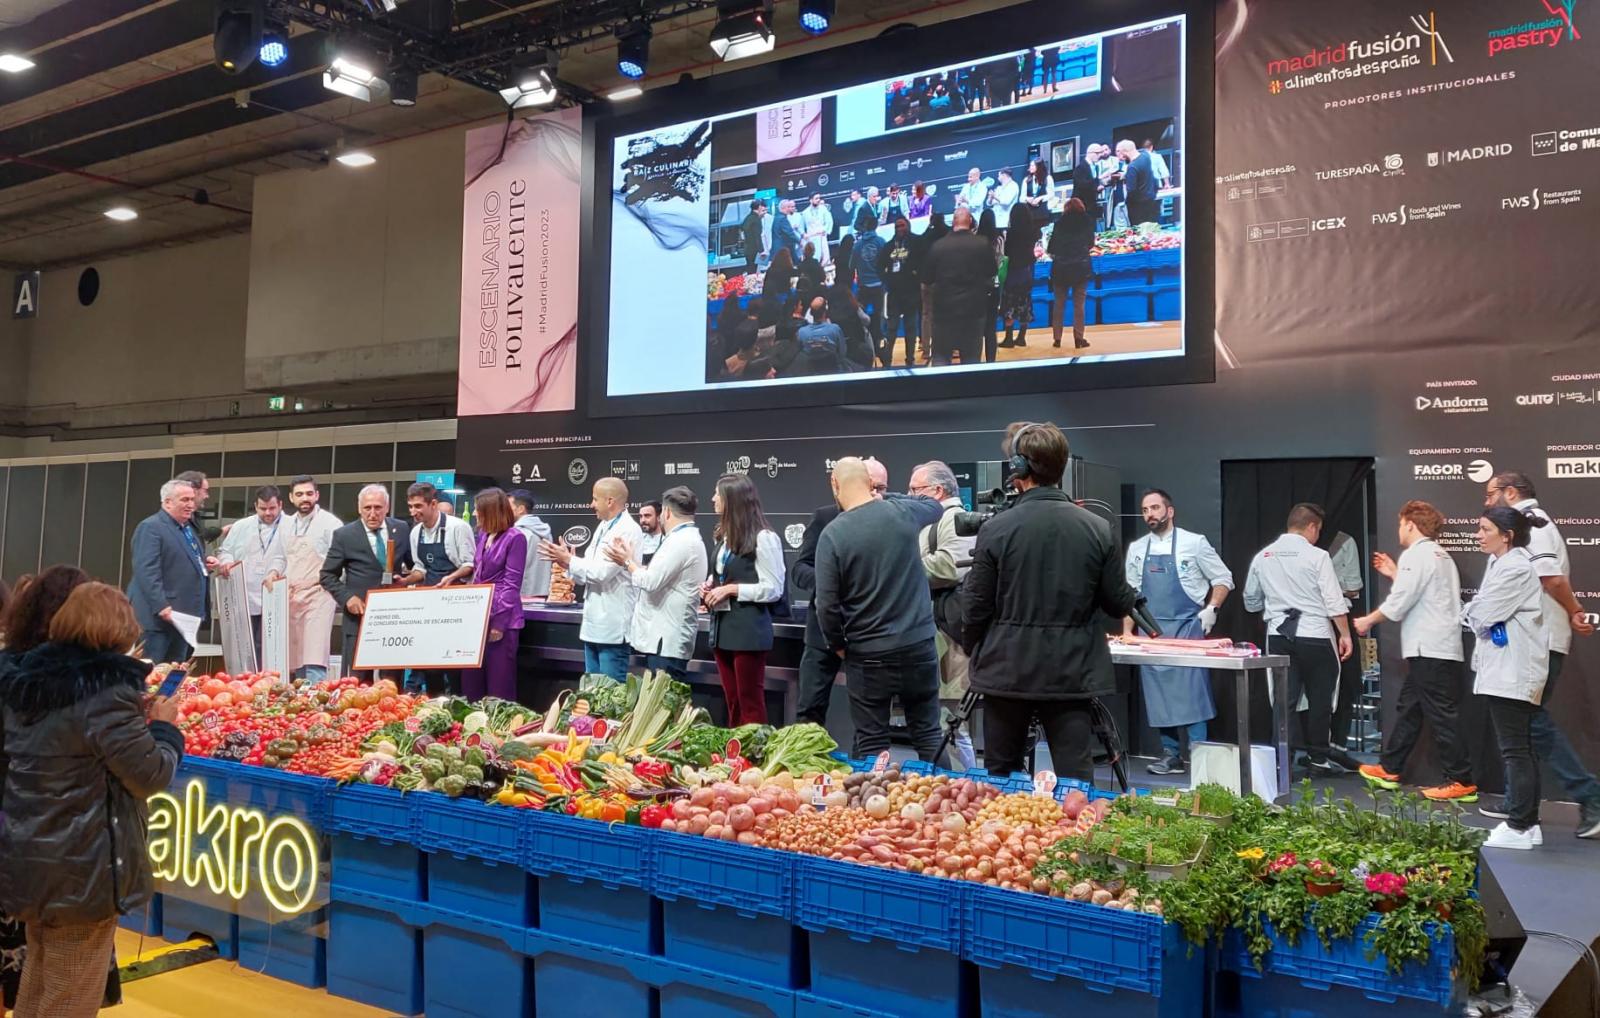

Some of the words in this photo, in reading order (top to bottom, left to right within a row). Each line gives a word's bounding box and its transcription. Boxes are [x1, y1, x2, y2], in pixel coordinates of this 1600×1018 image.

[1488, 27, 1564, 57] pastry
[1268, 54, 1420, 94] #alimentosdespaña
[1324, 89, 1403, 110] PROMOTORES
[1407, 70, 1516, 96] INSTITUCIONALES
[1559, 141, 1578, 152] de
[1447, 143, 1513, 163] MADRID
[1315, 164, 1380, 181] TURESPAÑA
[1543, 188, 1582, 199] Restaurants
[1560, 196, 1580, 205] Spain
[1409, 206, 1427, 214] Foods
[1441, 202, 1462, 211] Wines
[1426, 210, 1446, 219] Spain
[539, 208, 550, 334] #MadridFusion2023
[479, 190, 501, 368] ESCENARIO
[16, 279, 34, 314] A
[1432, 396, 1488, 409] Andorra
[1516, 393, 1554, 405] QUITO
[505, 437, 554, 445] PATROCINADORES
[555, 435, 592, 443] PRINCIPALES
[1409, 447, 1461, 455] EQUIPAMIENTO
[1414, 464, 1463, 475] FAGOR
[1555, 460, 1600, 474] mak
[1553, 517, 1593, 525] VEHÍCULO
